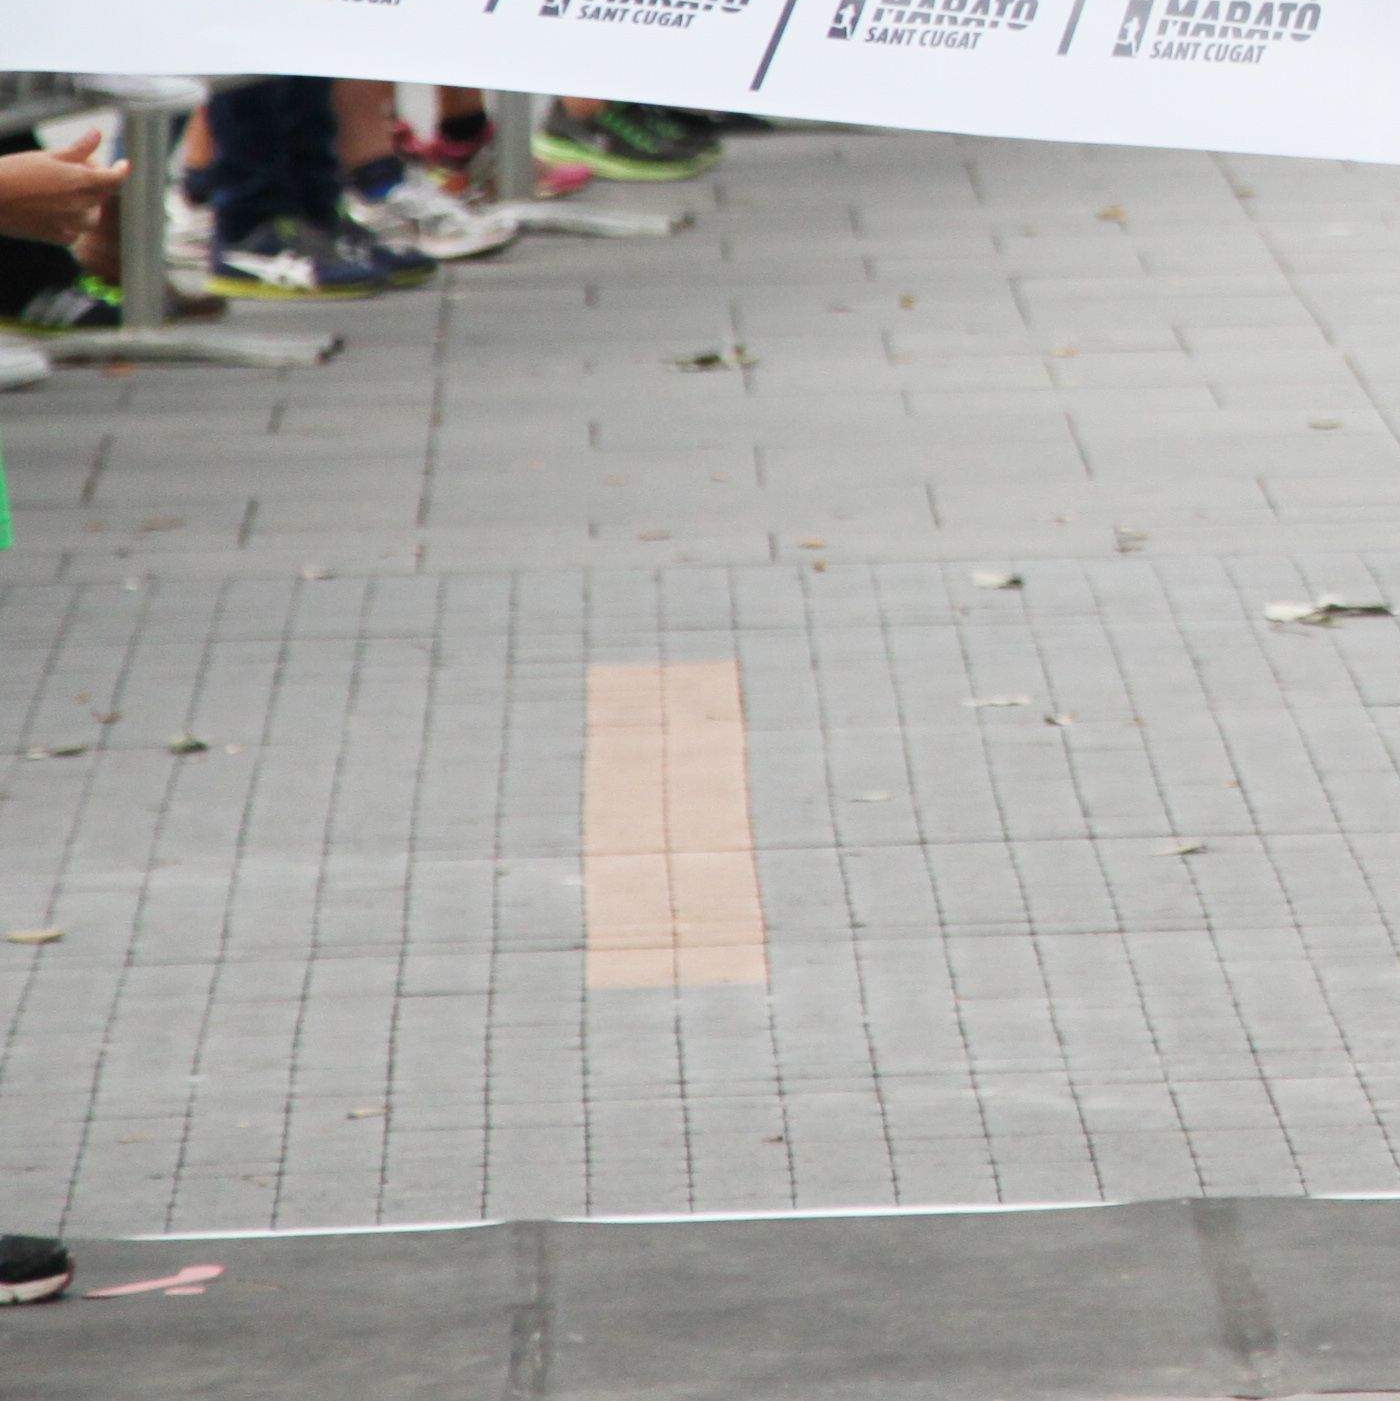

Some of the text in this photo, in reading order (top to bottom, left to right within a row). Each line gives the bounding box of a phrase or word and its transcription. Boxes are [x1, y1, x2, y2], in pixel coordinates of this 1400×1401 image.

[577, 5, 695, 28] SANT CUGAT
[865, 27, 982, 50] SANT CUGAT
[1150, 41, 1265, 64] SANT CUGAT
